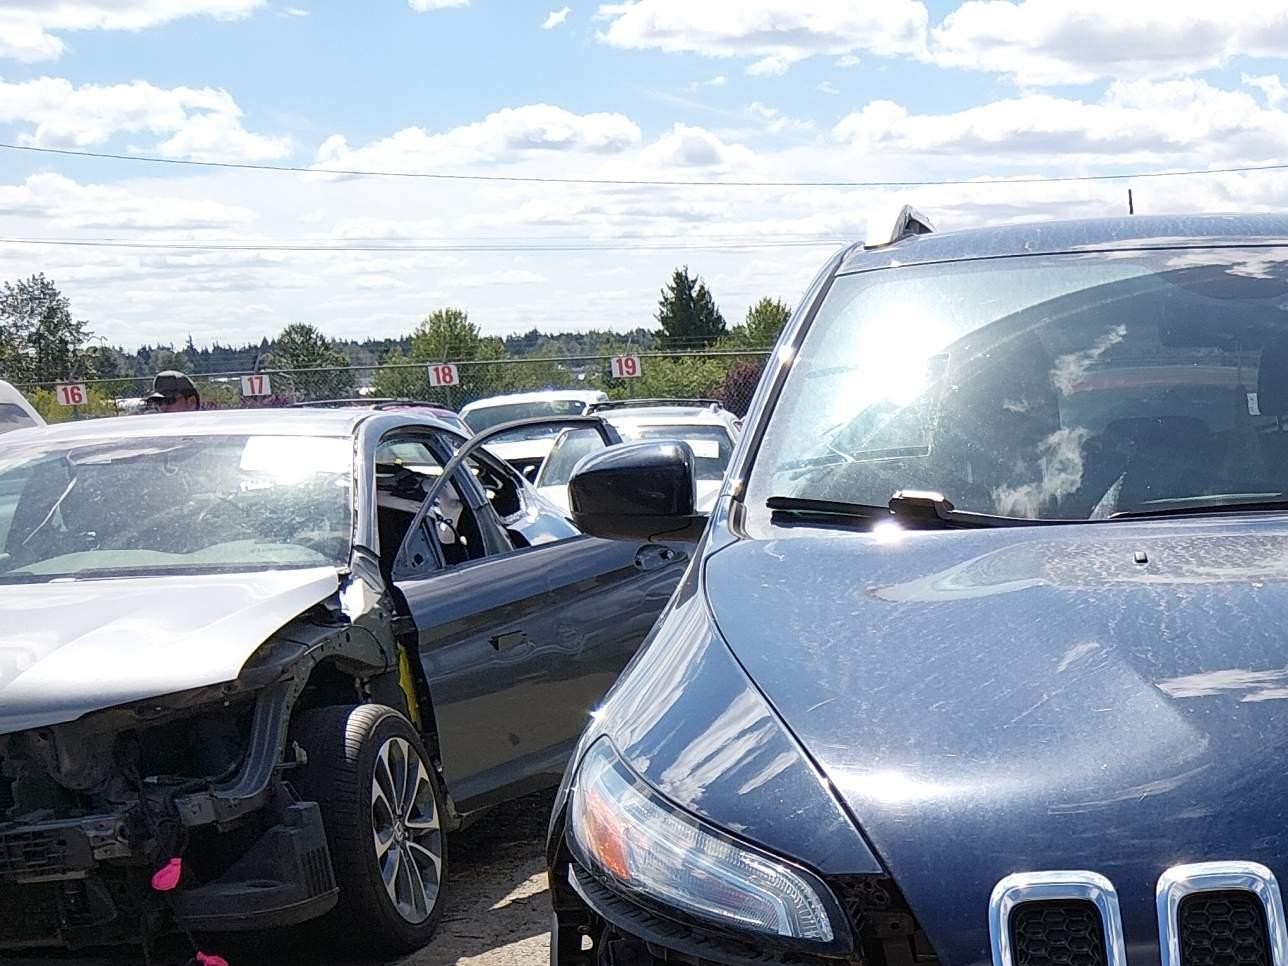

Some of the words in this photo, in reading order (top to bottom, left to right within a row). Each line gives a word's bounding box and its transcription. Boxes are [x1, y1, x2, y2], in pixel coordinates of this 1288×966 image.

[432, 366, 453, 385] 18
[616, 357, 637, 376] 19
[61, 386, 83, 404] 16
[247, 376, 265, 395] 17
